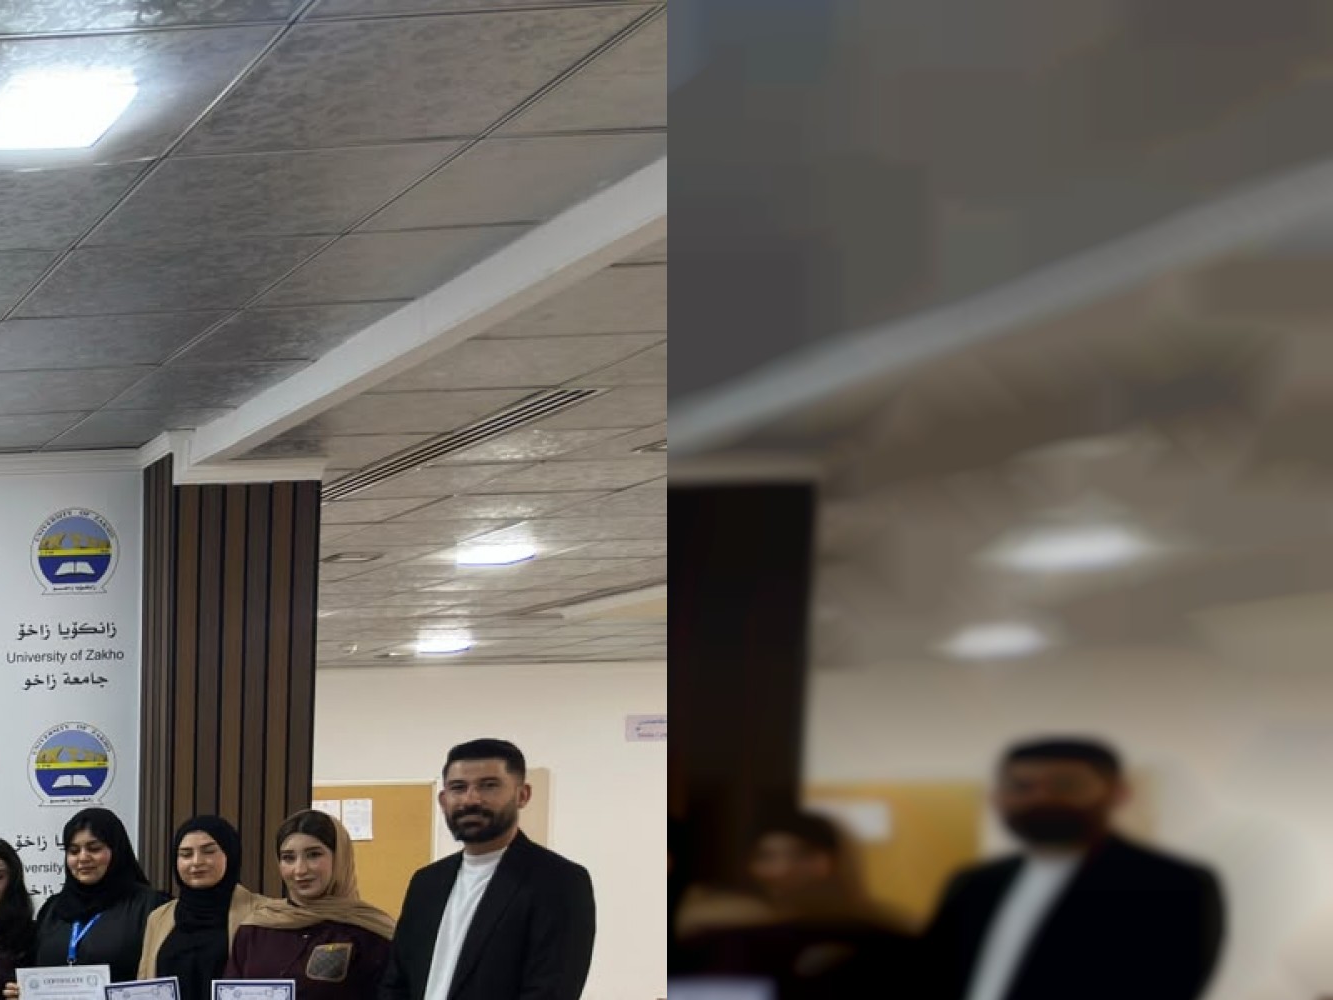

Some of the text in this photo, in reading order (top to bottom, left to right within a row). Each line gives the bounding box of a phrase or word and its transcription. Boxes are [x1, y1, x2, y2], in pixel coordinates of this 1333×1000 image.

[6, 648, 125, 666] University of Zakho
[21, 671, 109, 691] جامعة زاخو
[24, 862, 64, 876] versity
